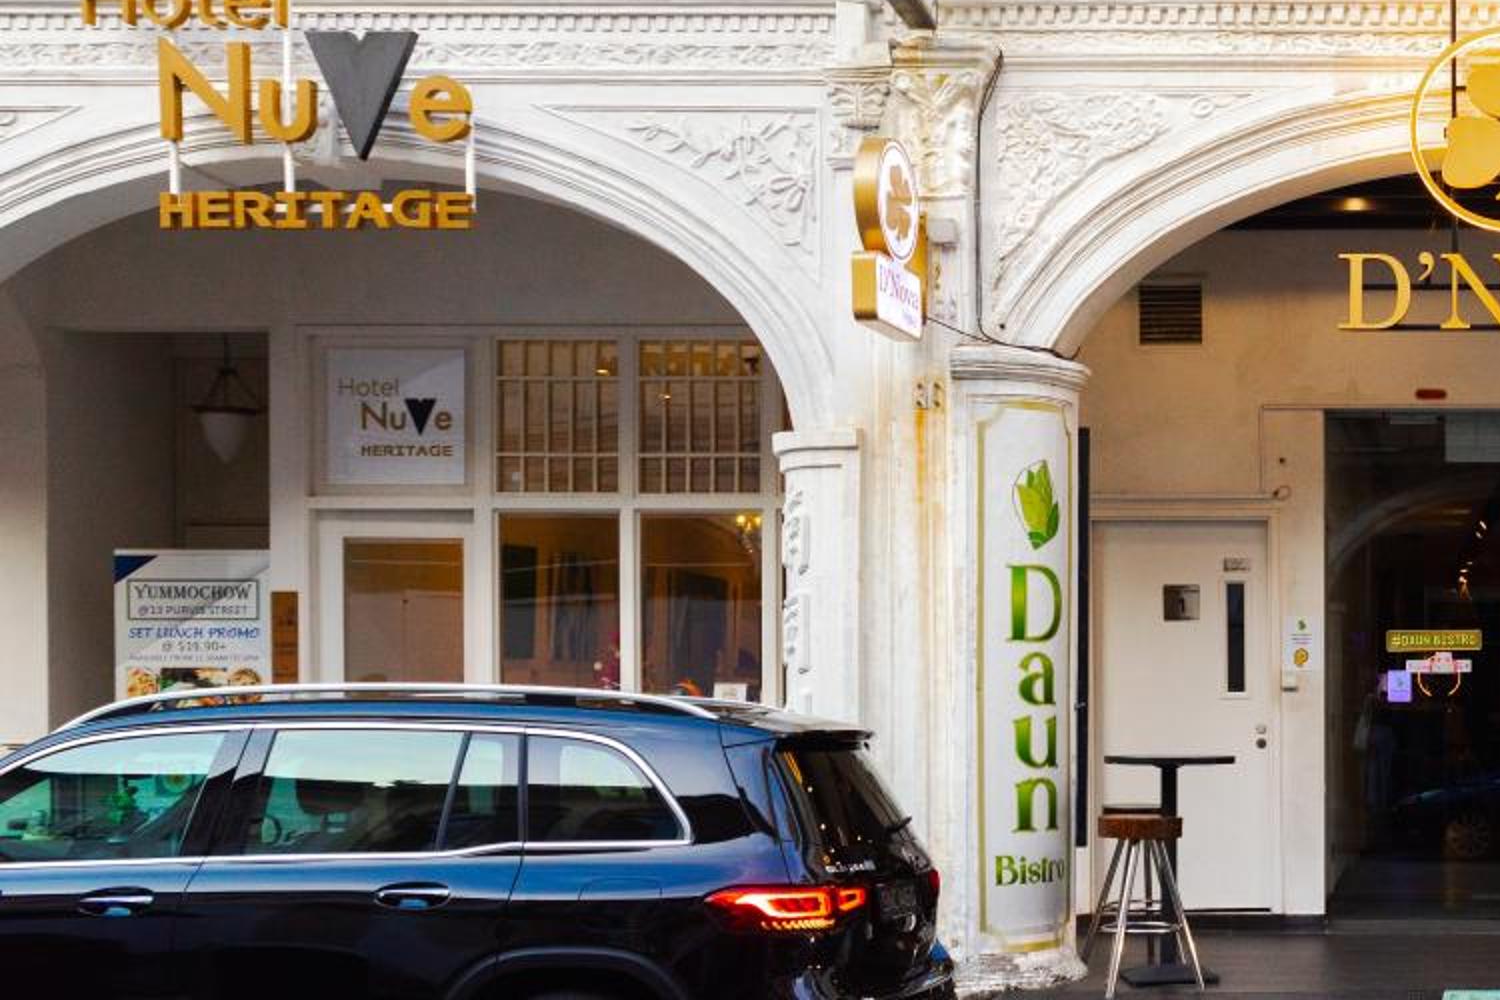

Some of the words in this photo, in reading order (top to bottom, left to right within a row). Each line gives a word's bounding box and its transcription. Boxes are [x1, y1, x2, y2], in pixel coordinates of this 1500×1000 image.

[158, 190, 476, 229] HERITAGE
[337, 378, 400, 397] Hotel
[361, 445, 453, 457] HERITAGE
[134, 583, 252, 600] YUMMOCHOW
[128, 627, 153, 639] SET
[156, 627, 204, 639] LUNCH
[207, 627, 260, 639] PROMO
[1005, 564, 1062, 833] Daun
[995, 854, 1065, 887] Bistro
